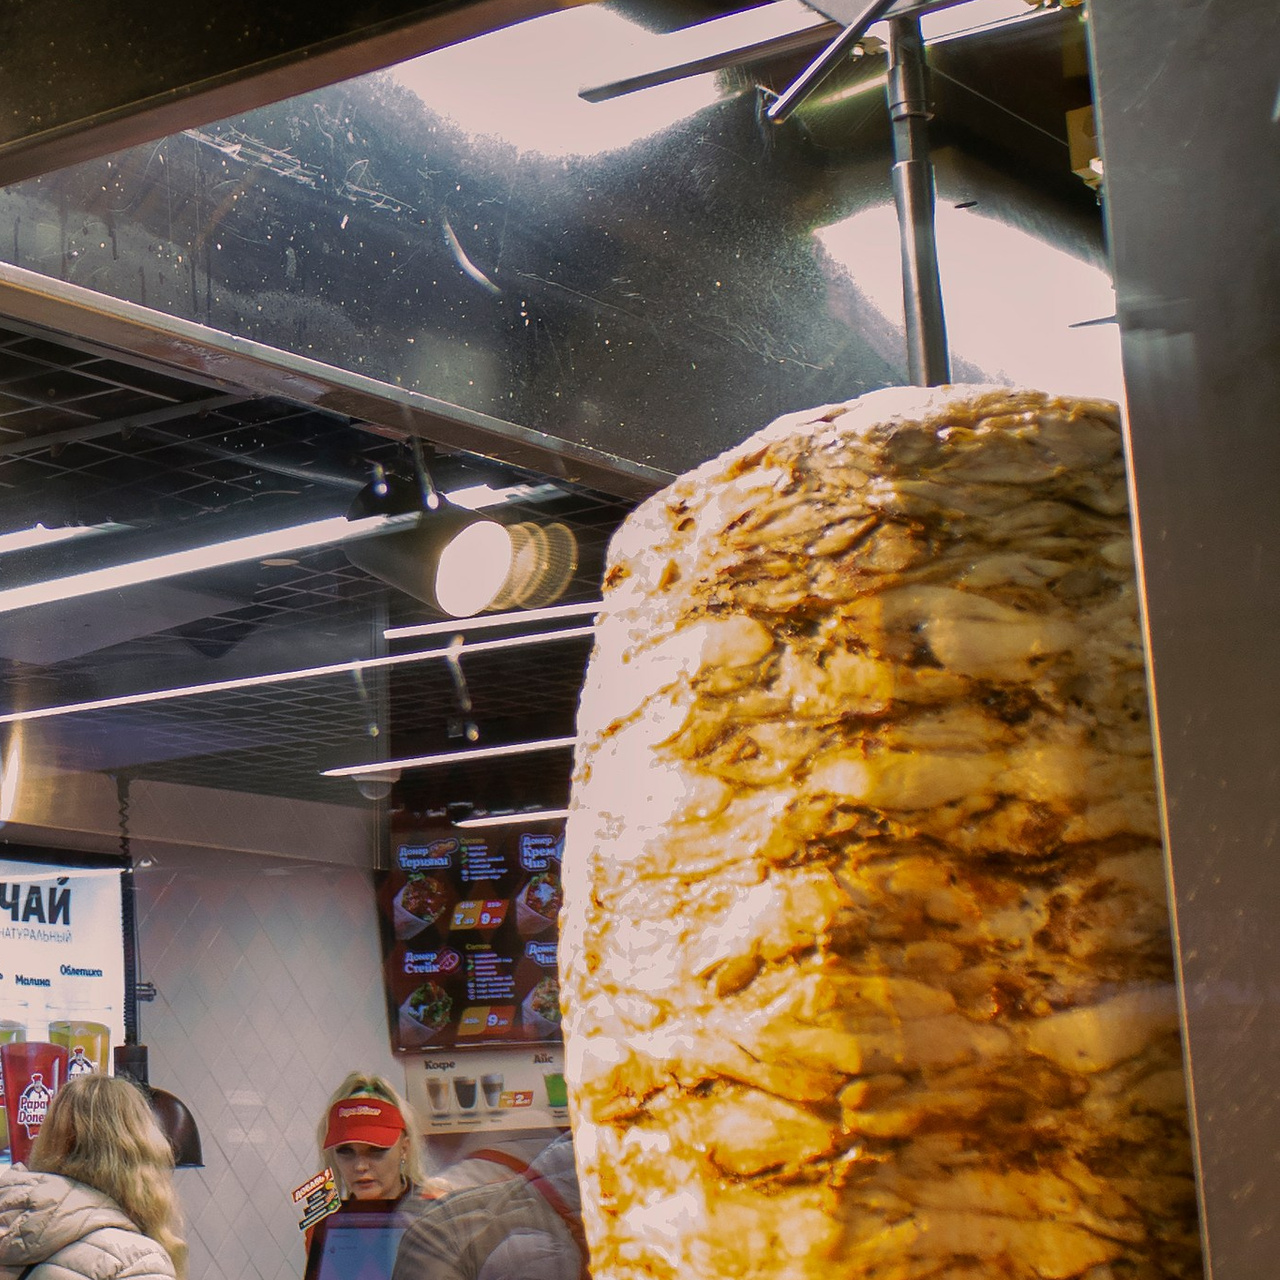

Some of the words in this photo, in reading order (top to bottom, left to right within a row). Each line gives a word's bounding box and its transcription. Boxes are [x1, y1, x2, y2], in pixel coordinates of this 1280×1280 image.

[60, 964, 103, 977] Облепиха
[15, 975, 51, 986] Малина
[534, 1054, 553, 1064] Айс
[424, 1060, 455, 1071] Кофе
[21, 1097, 45, 1111] Papa
[19, 1111, 44, 1122] Döne
